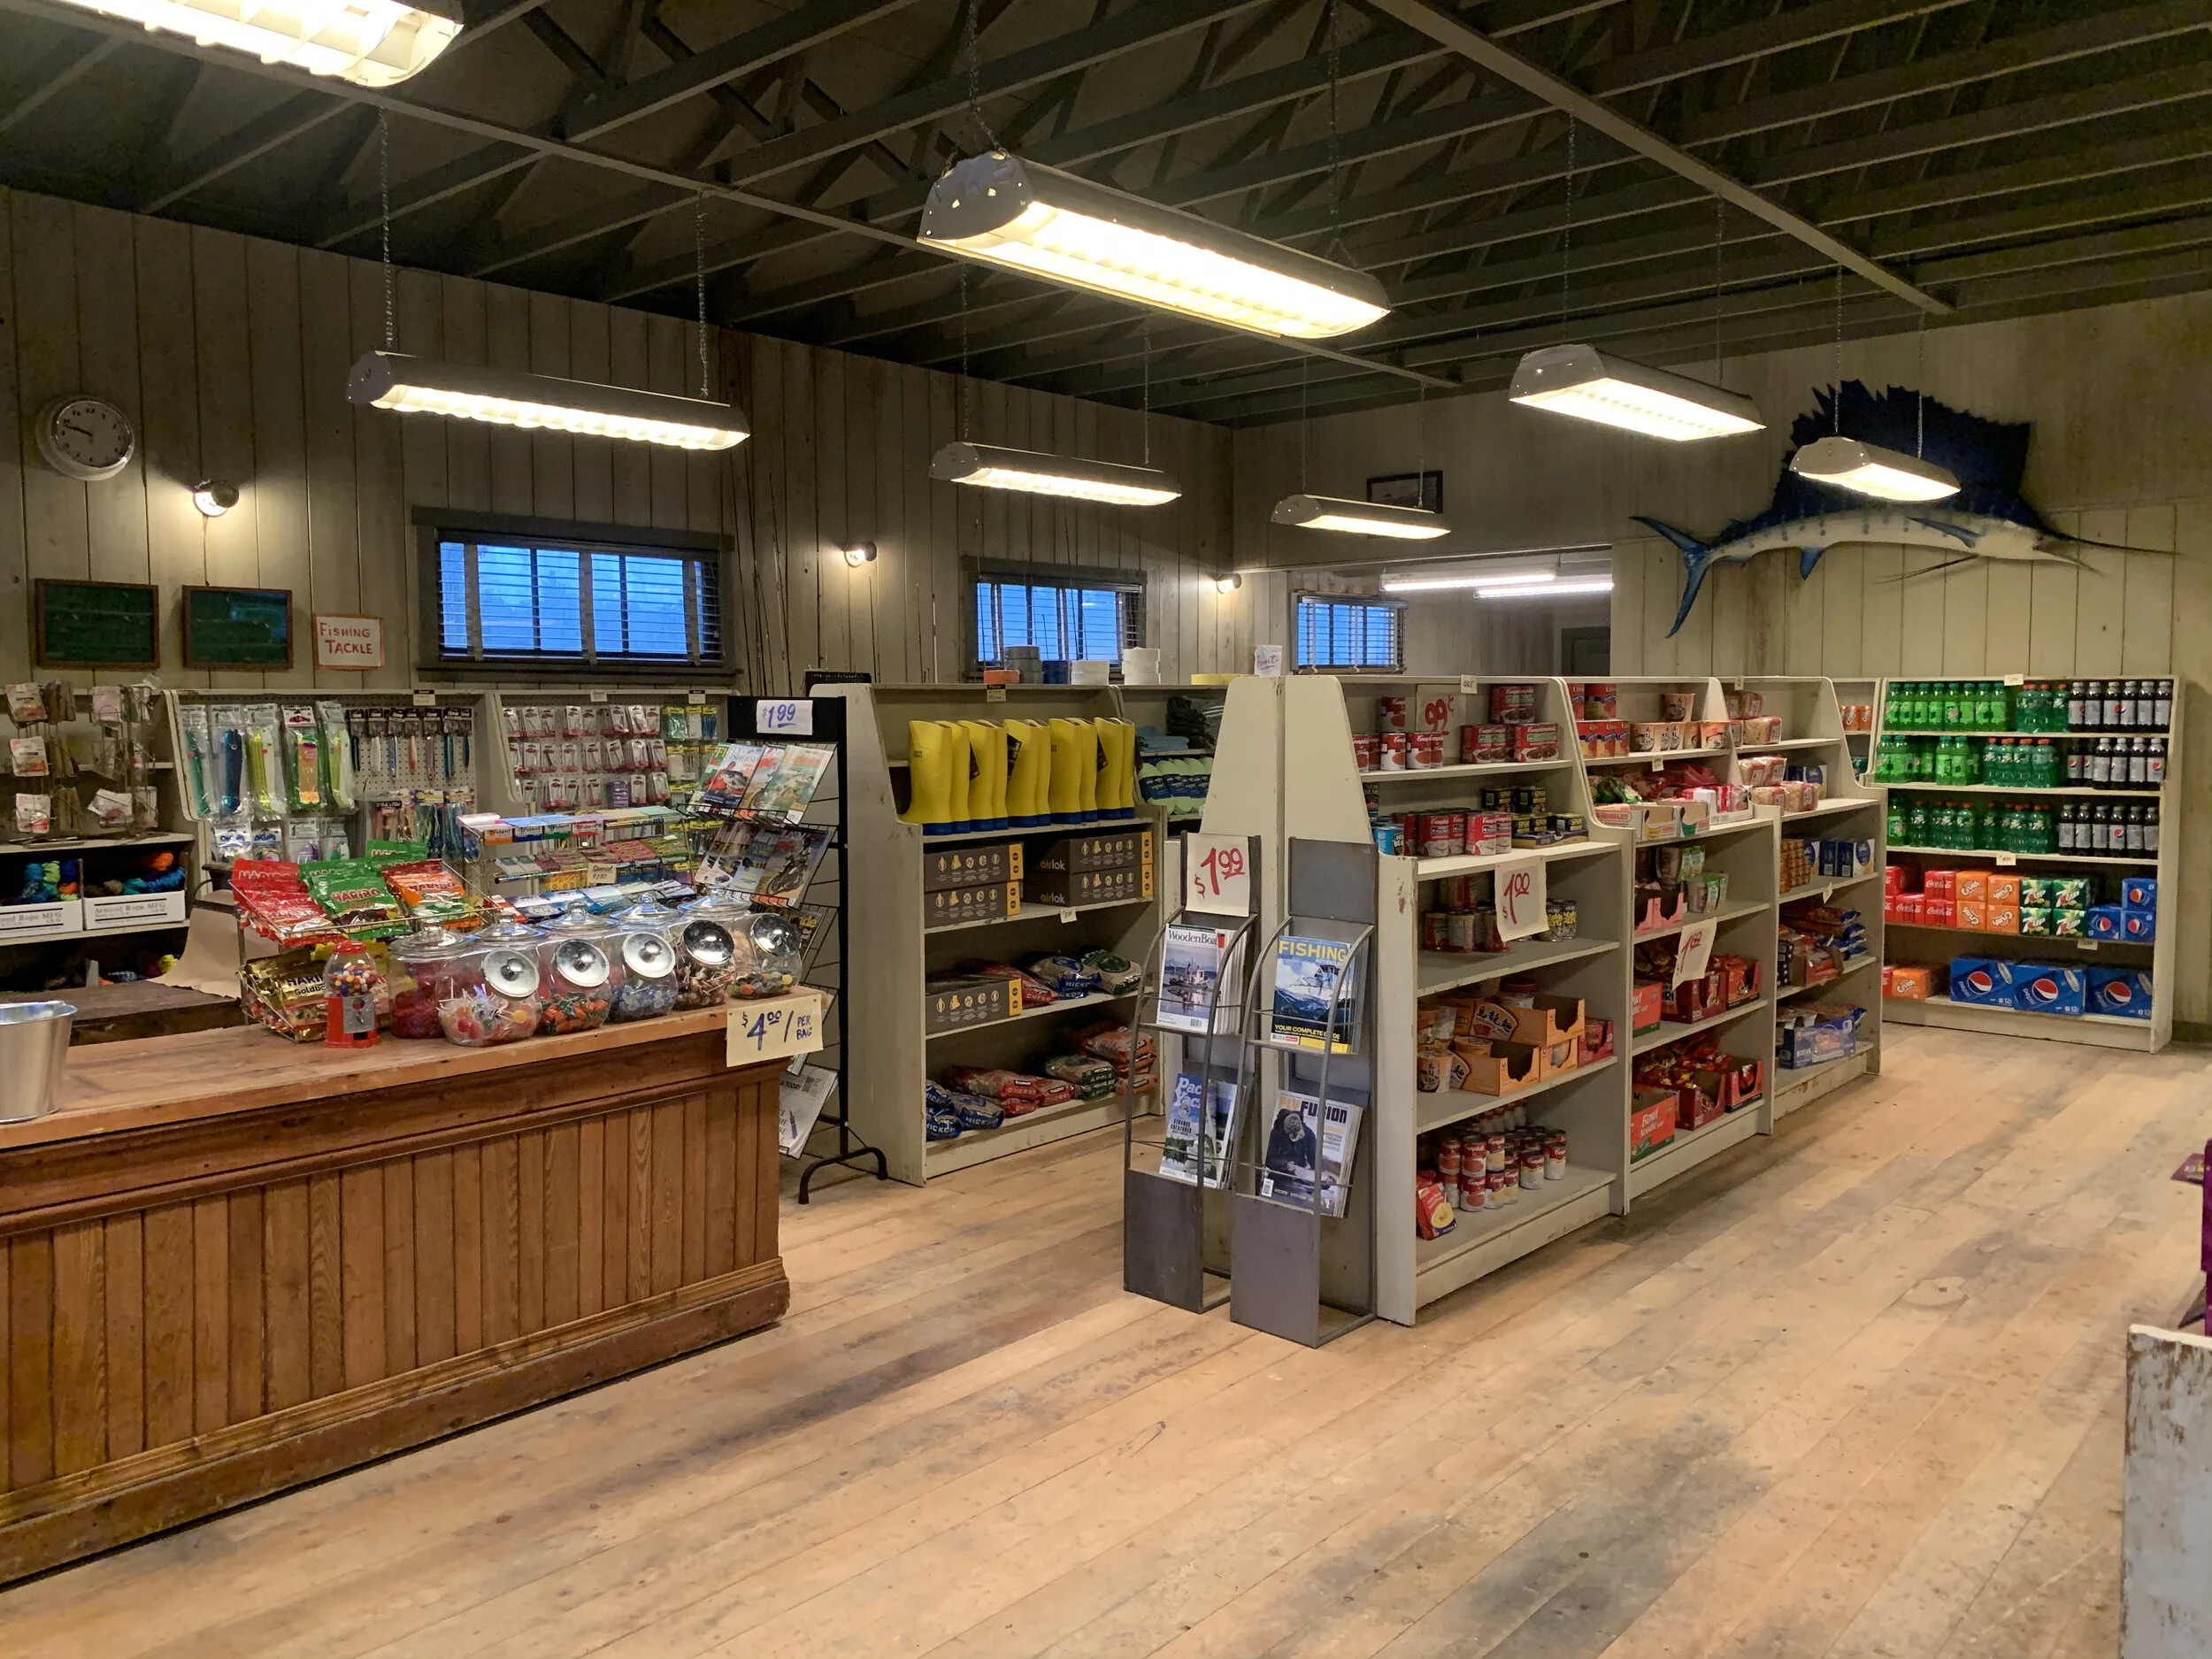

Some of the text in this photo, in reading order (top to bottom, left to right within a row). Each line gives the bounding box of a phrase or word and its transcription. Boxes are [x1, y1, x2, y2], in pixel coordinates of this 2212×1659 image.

[319, 622, 371, 637] FISHING
[325, 639, 373, 654] TACKLE
[1279, 940, 1348, 963] FISHING
[286, 974, 325, 987] HARI
[797, 1015, 811, 1027] PER
[796, 1027, 813, 1041] BAG
[1301, 1100, 1348, 1124] FUION
